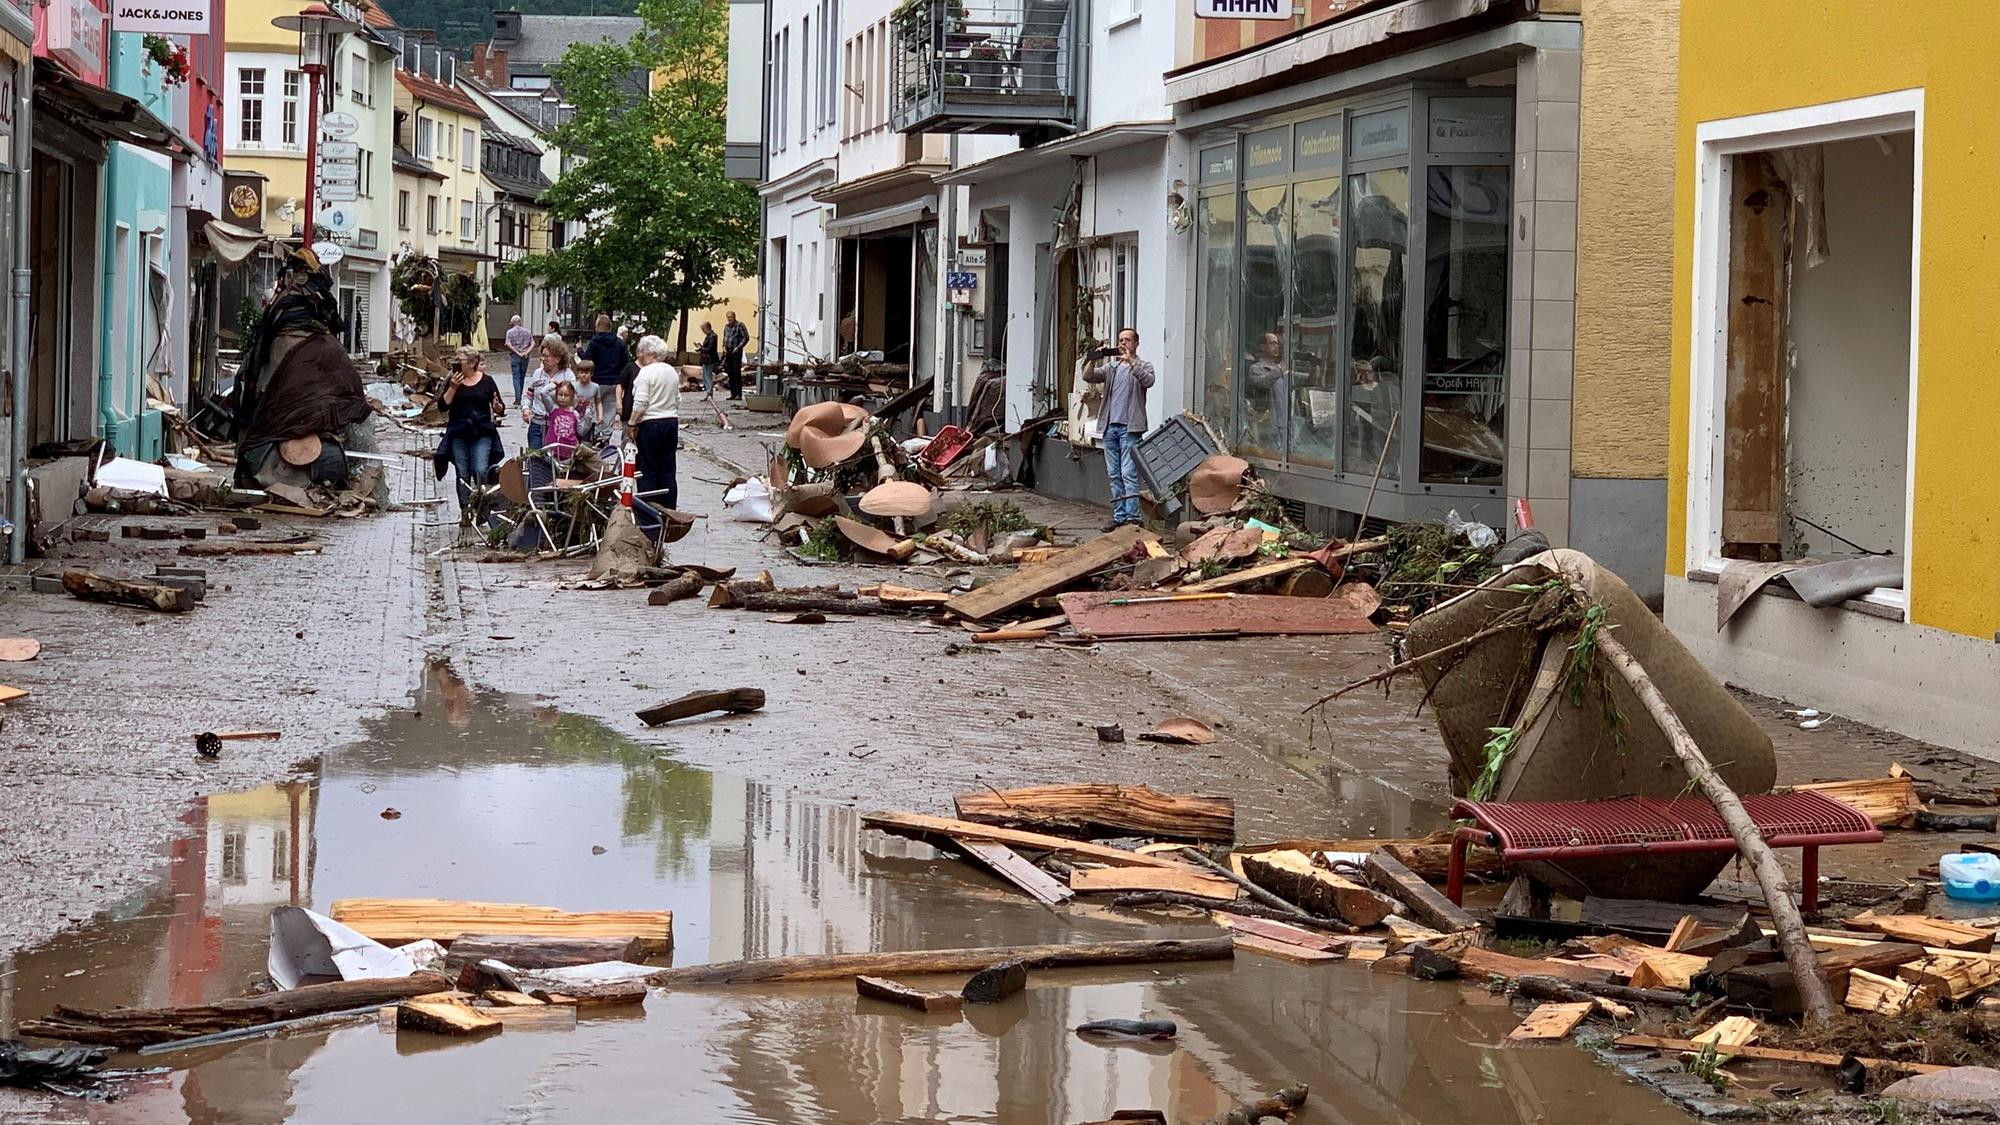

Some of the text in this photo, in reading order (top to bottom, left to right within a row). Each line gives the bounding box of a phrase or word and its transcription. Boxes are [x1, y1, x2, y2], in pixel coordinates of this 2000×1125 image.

[1212, 0, 1278, 13] HAHN
[119, 8, 203, 21] JACK&JONES
[965, 255, 978, 264] Alte
[1436, 377, 1463, 390] Optik
